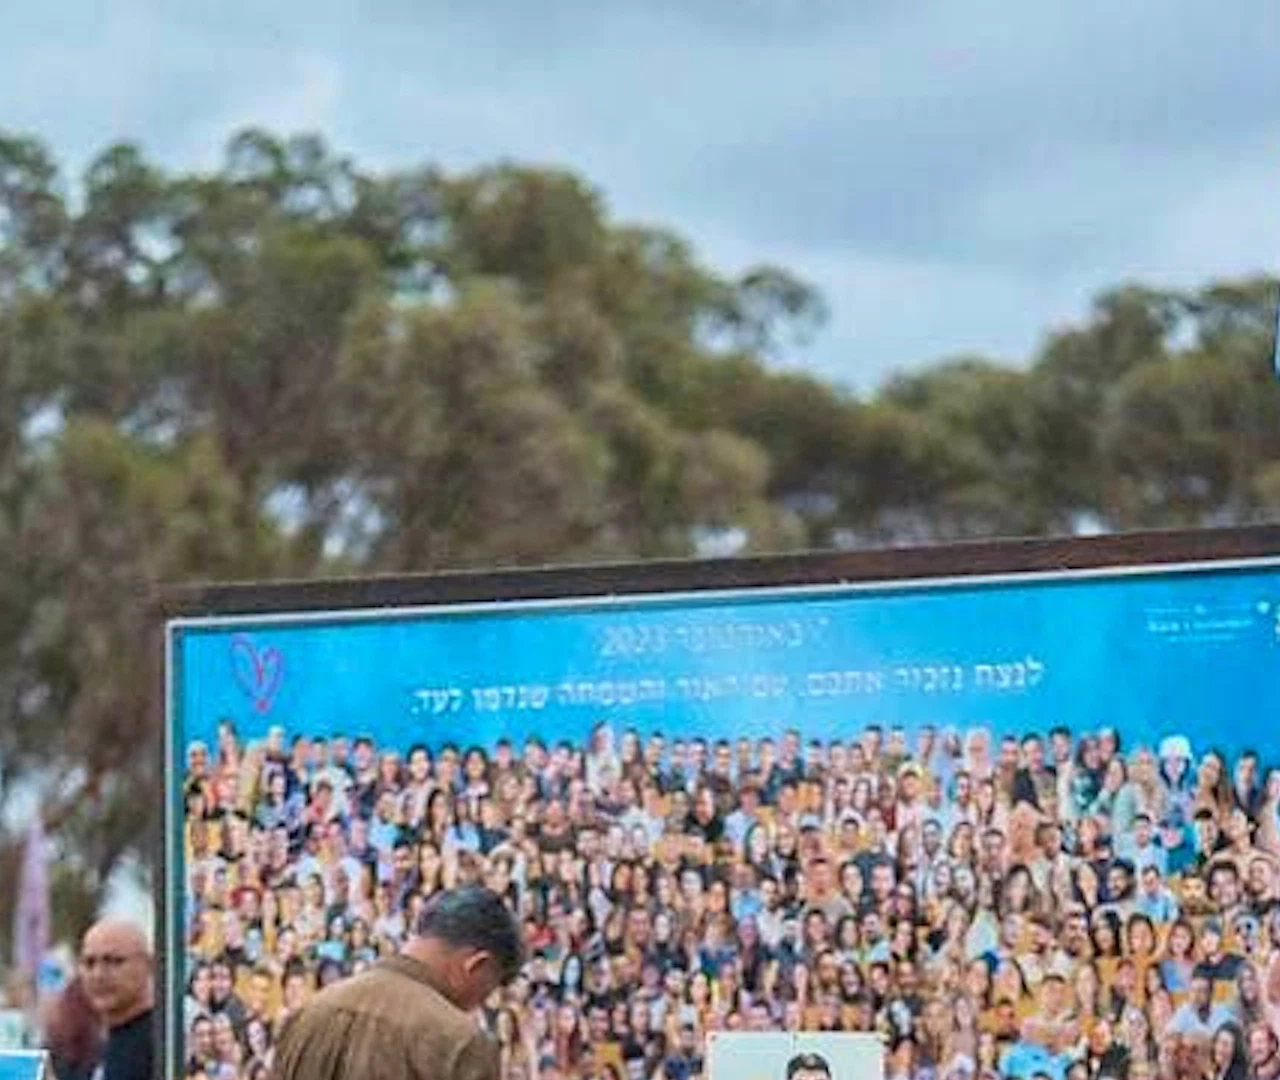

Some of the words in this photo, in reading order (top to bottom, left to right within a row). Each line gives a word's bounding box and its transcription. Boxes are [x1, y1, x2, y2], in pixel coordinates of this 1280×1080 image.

[599, 624, 667, 657] 2023
[893, 664, 963, 696] נזכור
[973, 654, 1043, 690] לנצח
